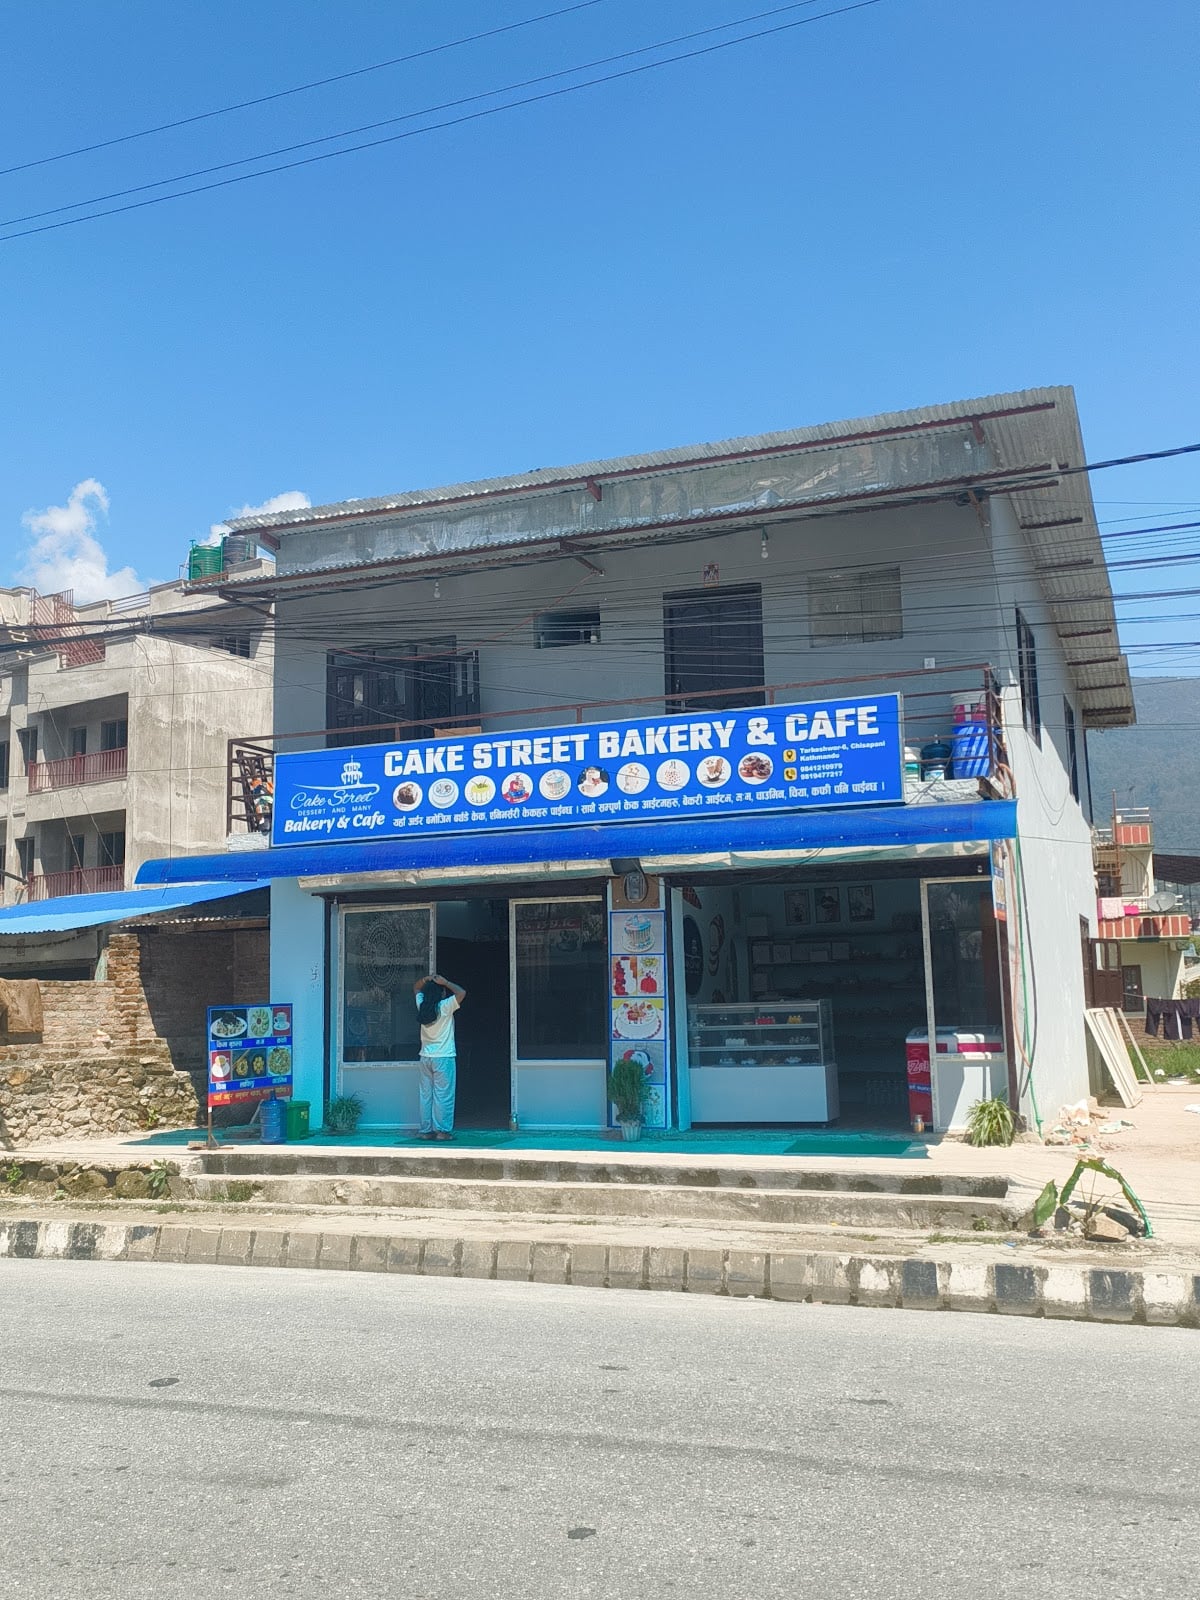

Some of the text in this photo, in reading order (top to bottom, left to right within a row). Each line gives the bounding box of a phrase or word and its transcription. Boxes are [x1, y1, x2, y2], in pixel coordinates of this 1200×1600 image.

[384, 705, 879, 777] CAKE STREET BAKERY & CAFE
[850, 740, 886, 750] Chisapani
[800, 753, 840, 762] Kathmandu
[290, 790, 374, 809] Cake Street
[623, 798, 640, 810] केक
[298, 808, 326, 816] DESSERT
[284, 811, 386, 833] Bakery & Cafe
